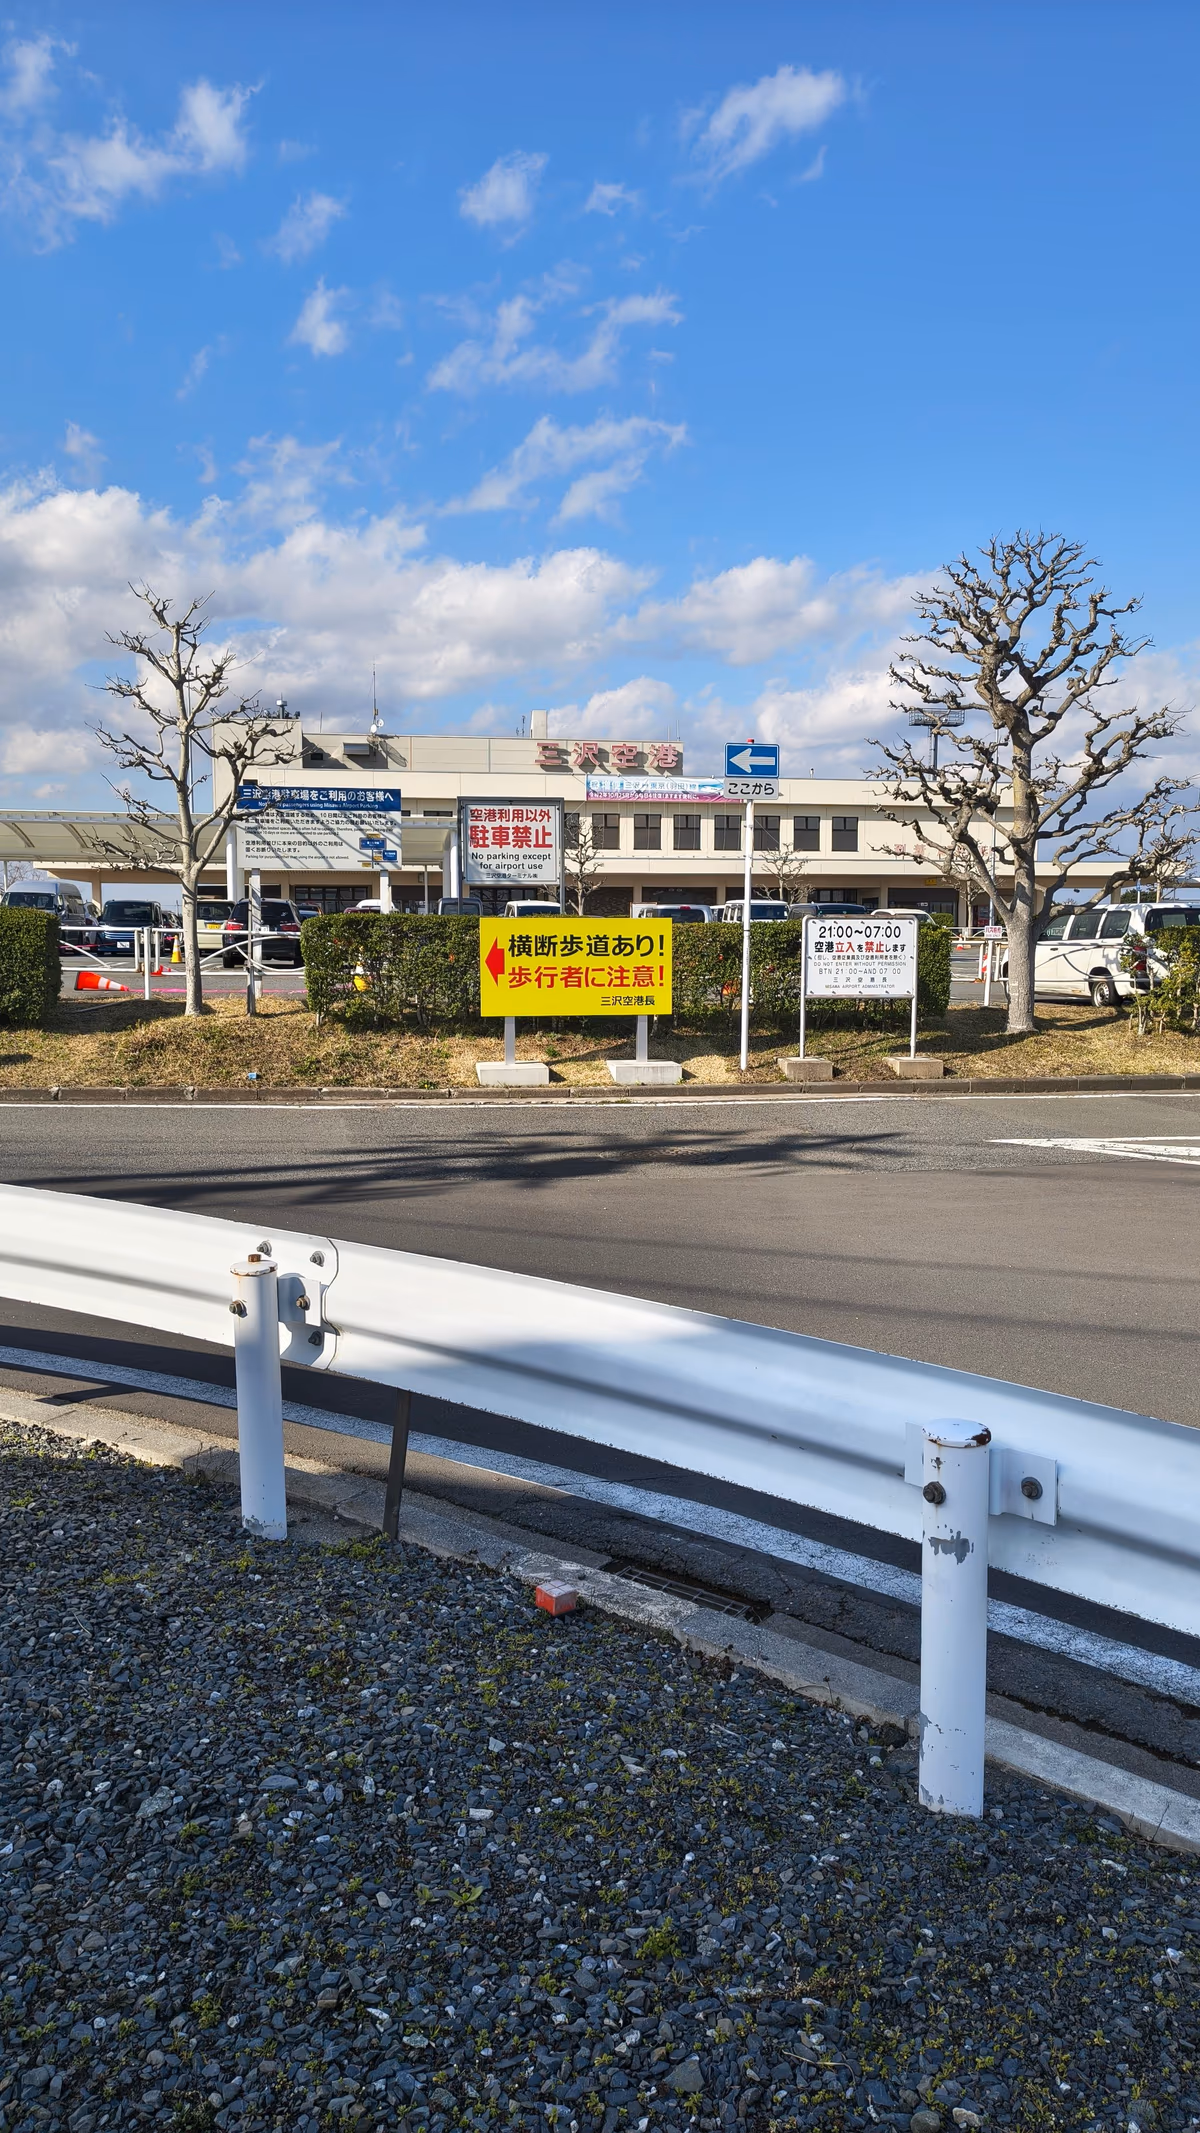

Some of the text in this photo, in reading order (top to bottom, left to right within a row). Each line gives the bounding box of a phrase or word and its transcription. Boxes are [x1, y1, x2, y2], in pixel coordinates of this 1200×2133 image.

[534, 743, 678, 768] 三沢空港
[728, 783, 775, 796] ここから
[470, 808, 552, 823] 空港利用以外
[470, 825, 553, 849] 駐車禁止
[472, 852, 551, 861] No parking except
[495, 862, 525, 871] airport
[819, 926, 901, 938] 21:00~07:00
[508, 934, 665, 958] 横断歩道あり!
[814, 941, 906, 953] 空港立入を禁止します
[508, 965, 664, 989] 歩行者に注意!
[600, 996, 656, 1007] 三沢空港長
